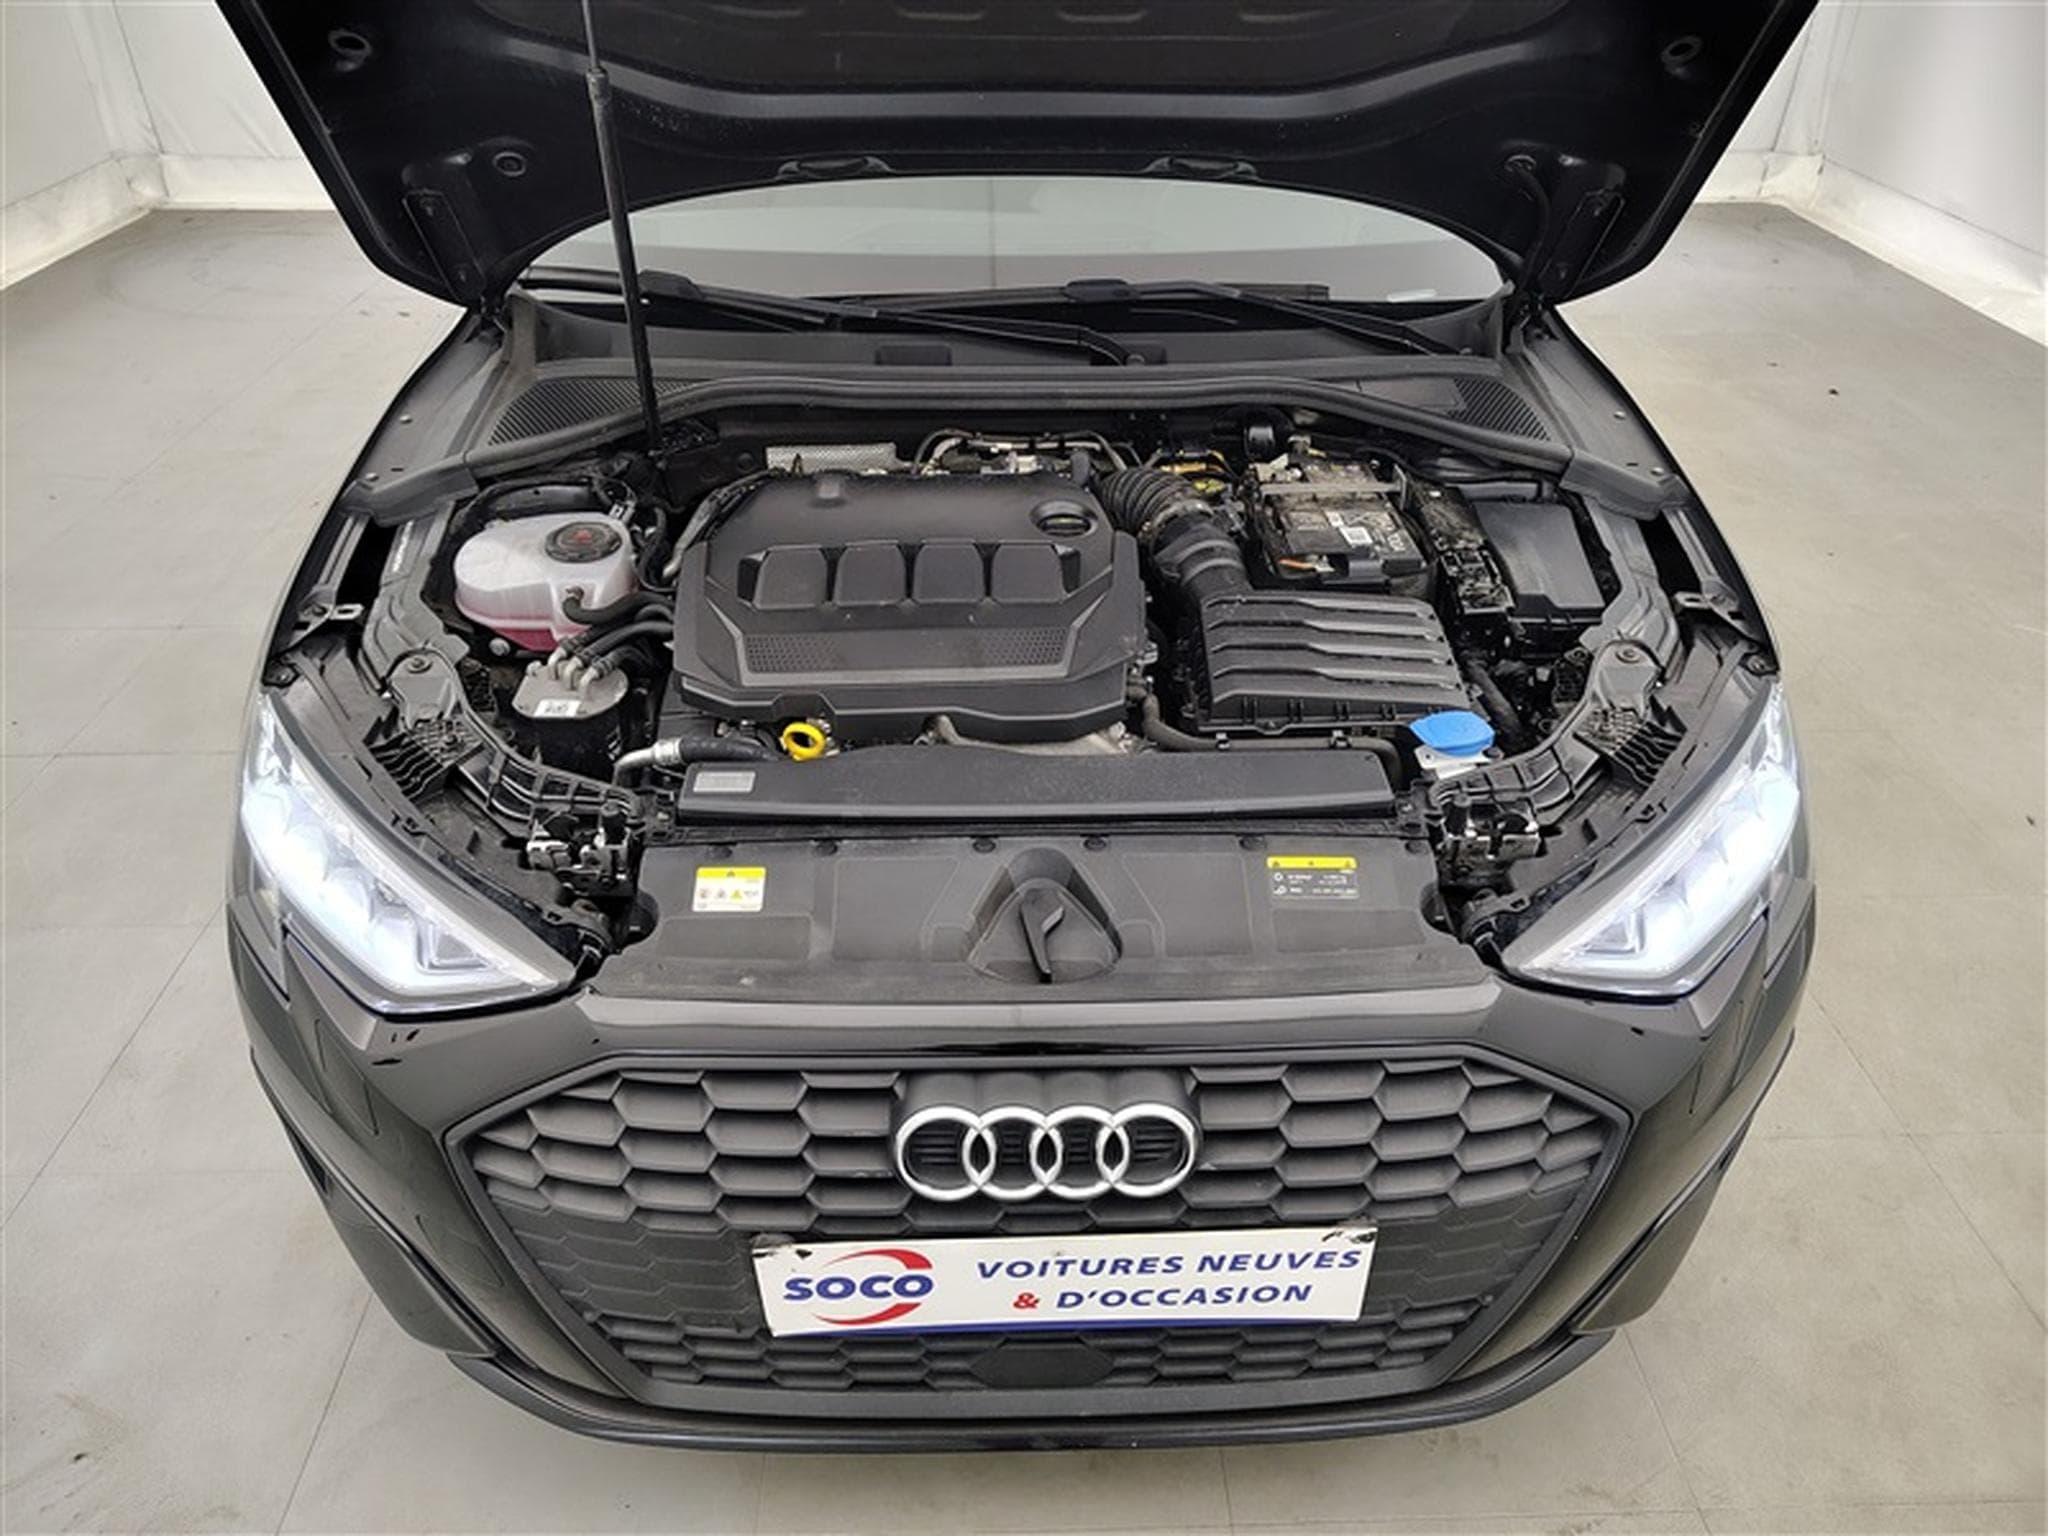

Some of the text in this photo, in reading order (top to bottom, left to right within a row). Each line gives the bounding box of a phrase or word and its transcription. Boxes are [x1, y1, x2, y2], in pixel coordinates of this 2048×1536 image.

[976, 1249, 1362, 1280] VOITURES NEUVES
[783, 1274, 935, 1302] SOCO
[1012, 1284, 1313, 1310] & D'OCCASION
